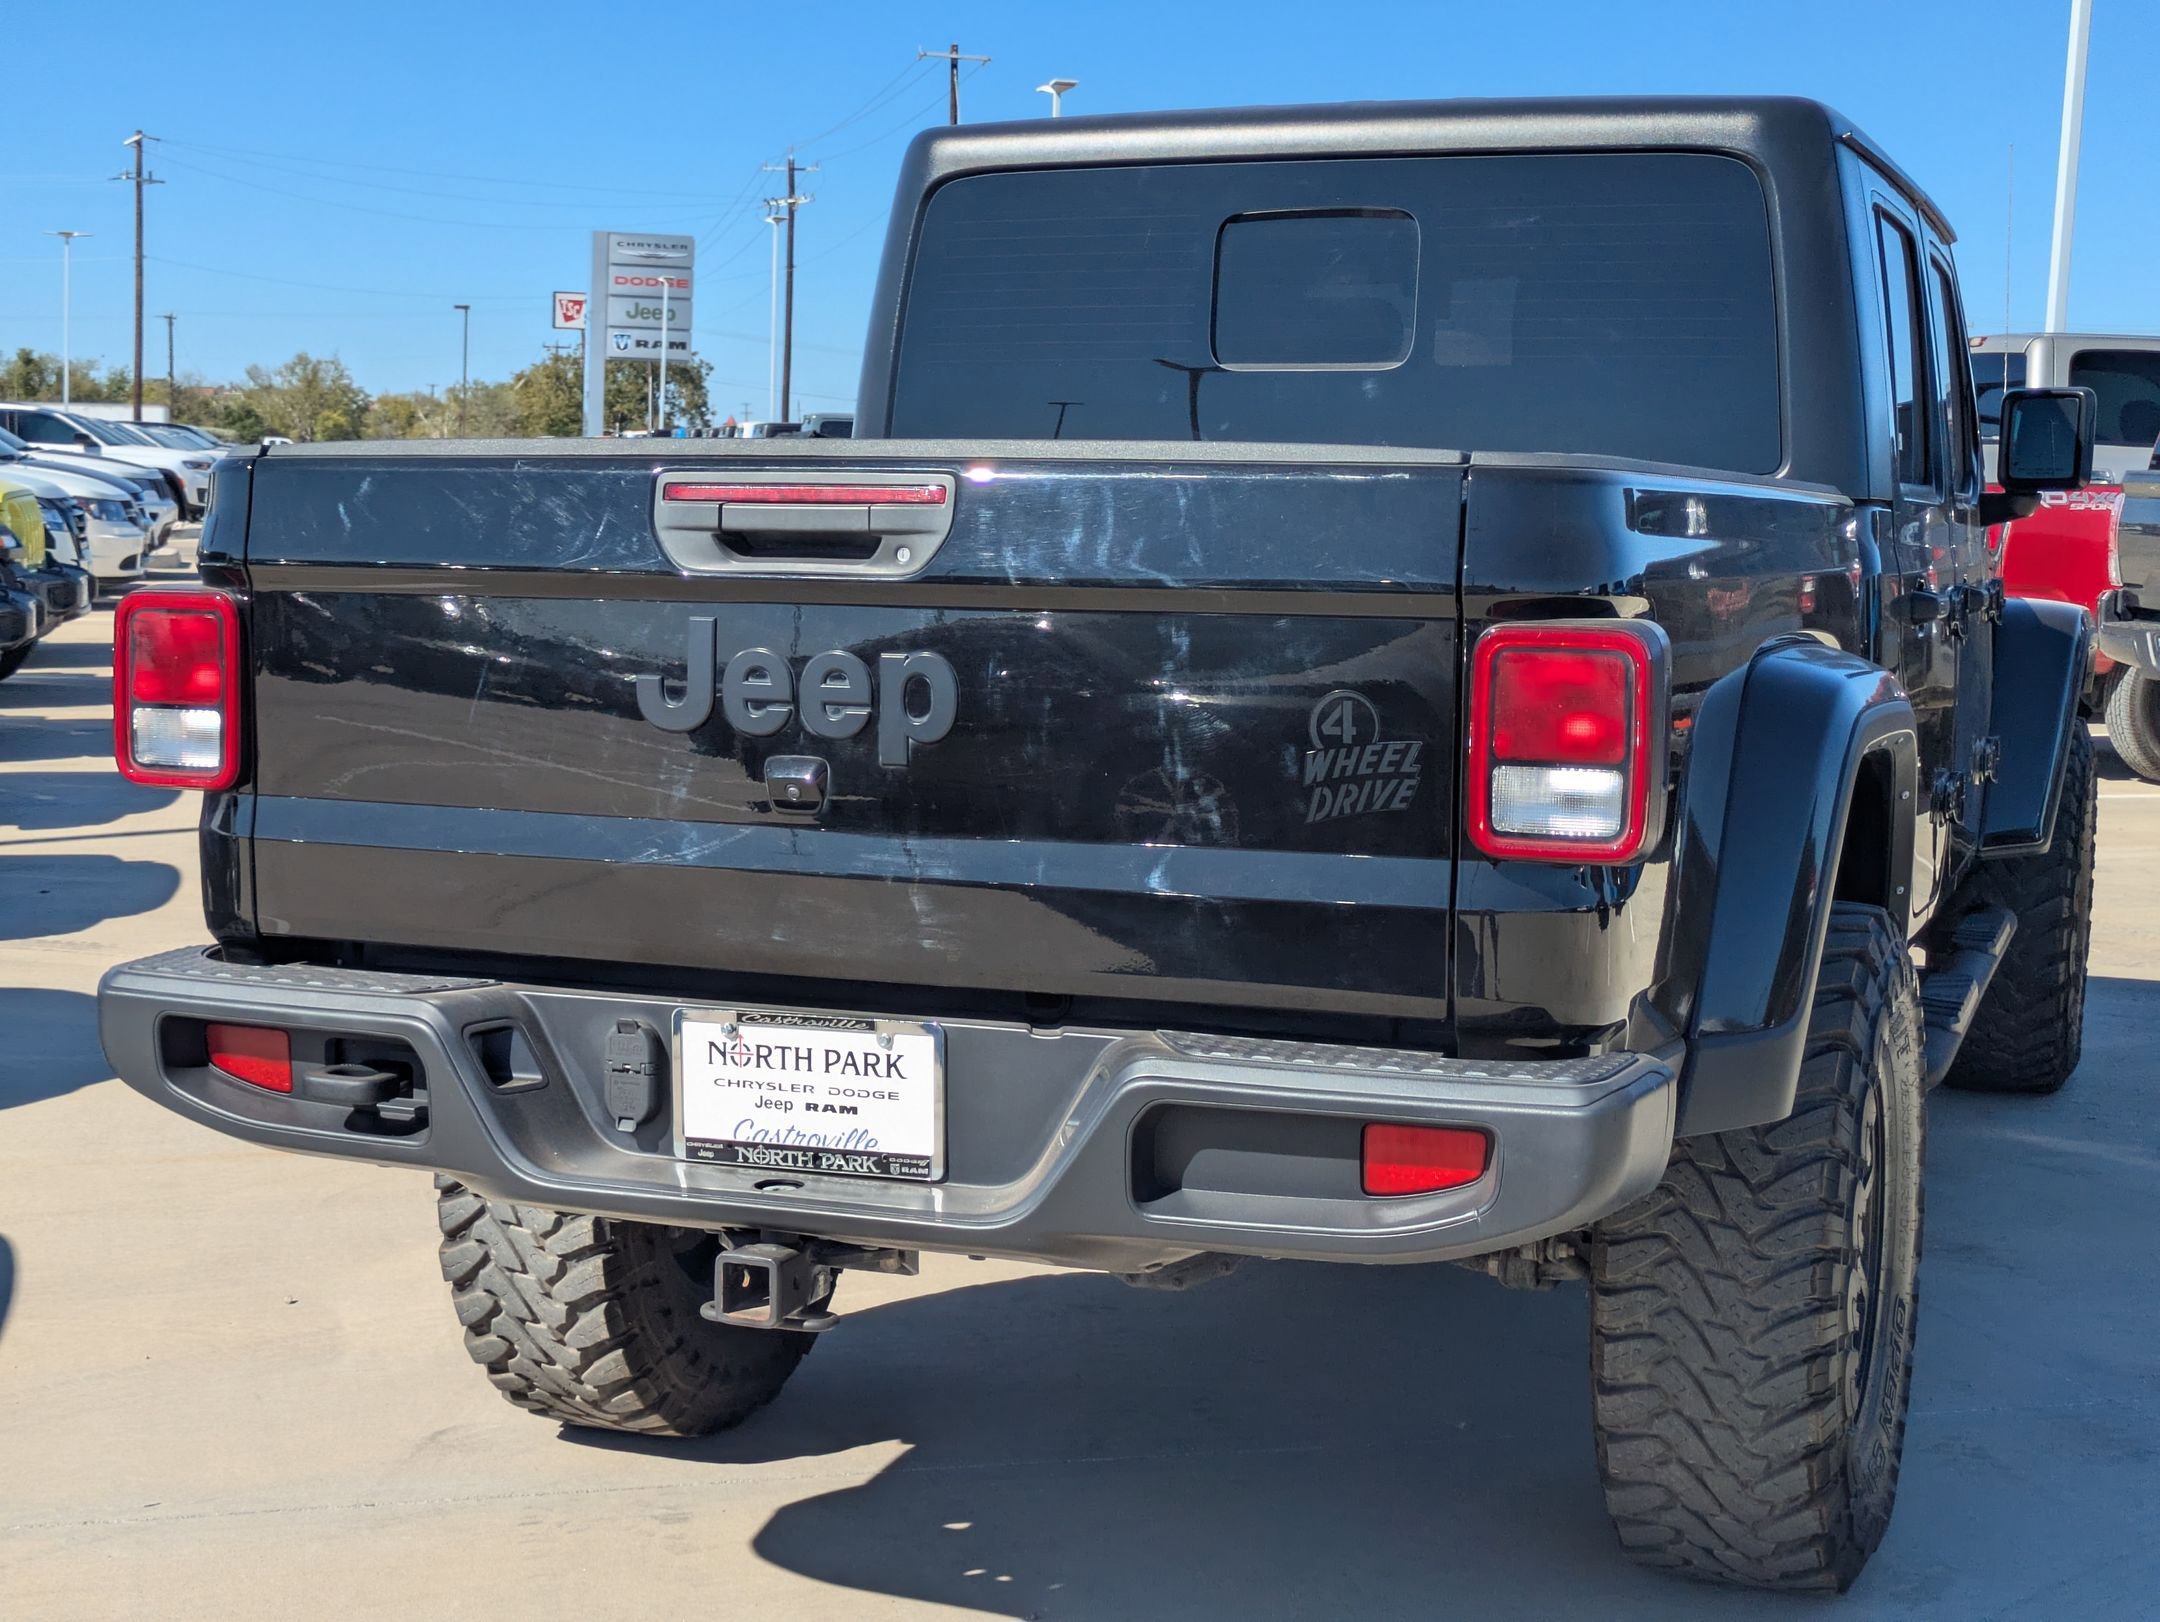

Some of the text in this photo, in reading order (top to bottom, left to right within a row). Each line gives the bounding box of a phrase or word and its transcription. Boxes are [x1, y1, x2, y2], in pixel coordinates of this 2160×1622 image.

[617, 241, 688, 250] CHRYSLER
[635, 339, 687, 351] RAM
[636, 616, 960, 767] Jeep
[1321, 700, 1357, 744] 4
[1304, 741, 1423, 786] WHEEL
[1304, 778, 1419, 823] DRIVE
[741, 1013, 869, 1031] Castroville
[707, 1040, 908, 1080] NORTH PARK
[713, 1078, 901, 1101] CHRYSLER DODGE
[754, 1095, 858, 1115] Jeep RAM
[733, 1118, 880, 1150] Castroville
[735, 1144, 882, 1174] NORTH PARK
[901, 1166, 929, 1175] RAM
[1879, 1293, 1907, 1441] OPEN
